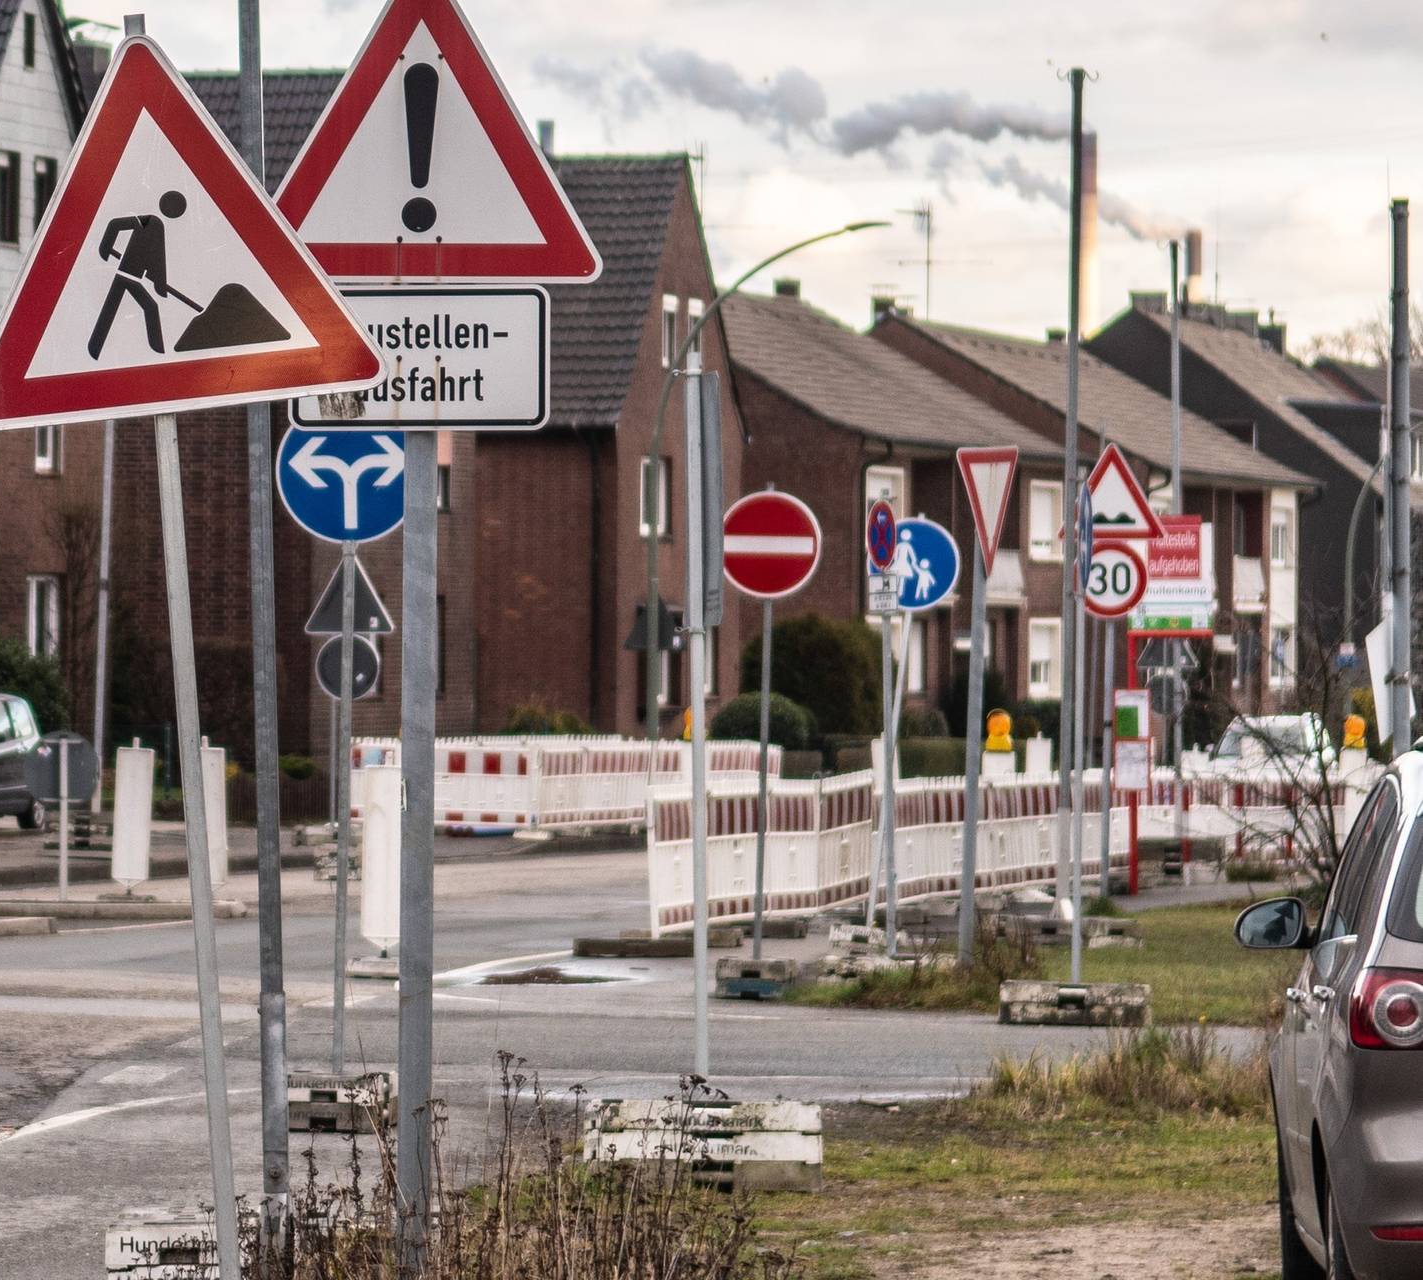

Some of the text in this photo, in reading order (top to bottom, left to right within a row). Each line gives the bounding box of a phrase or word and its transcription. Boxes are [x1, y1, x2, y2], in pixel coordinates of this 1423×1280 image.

[368, 314, 508, 349] ustellen-
[1088, 562, 1131, 596] 30
[119, 1236, 218, 1253] Hundertm
